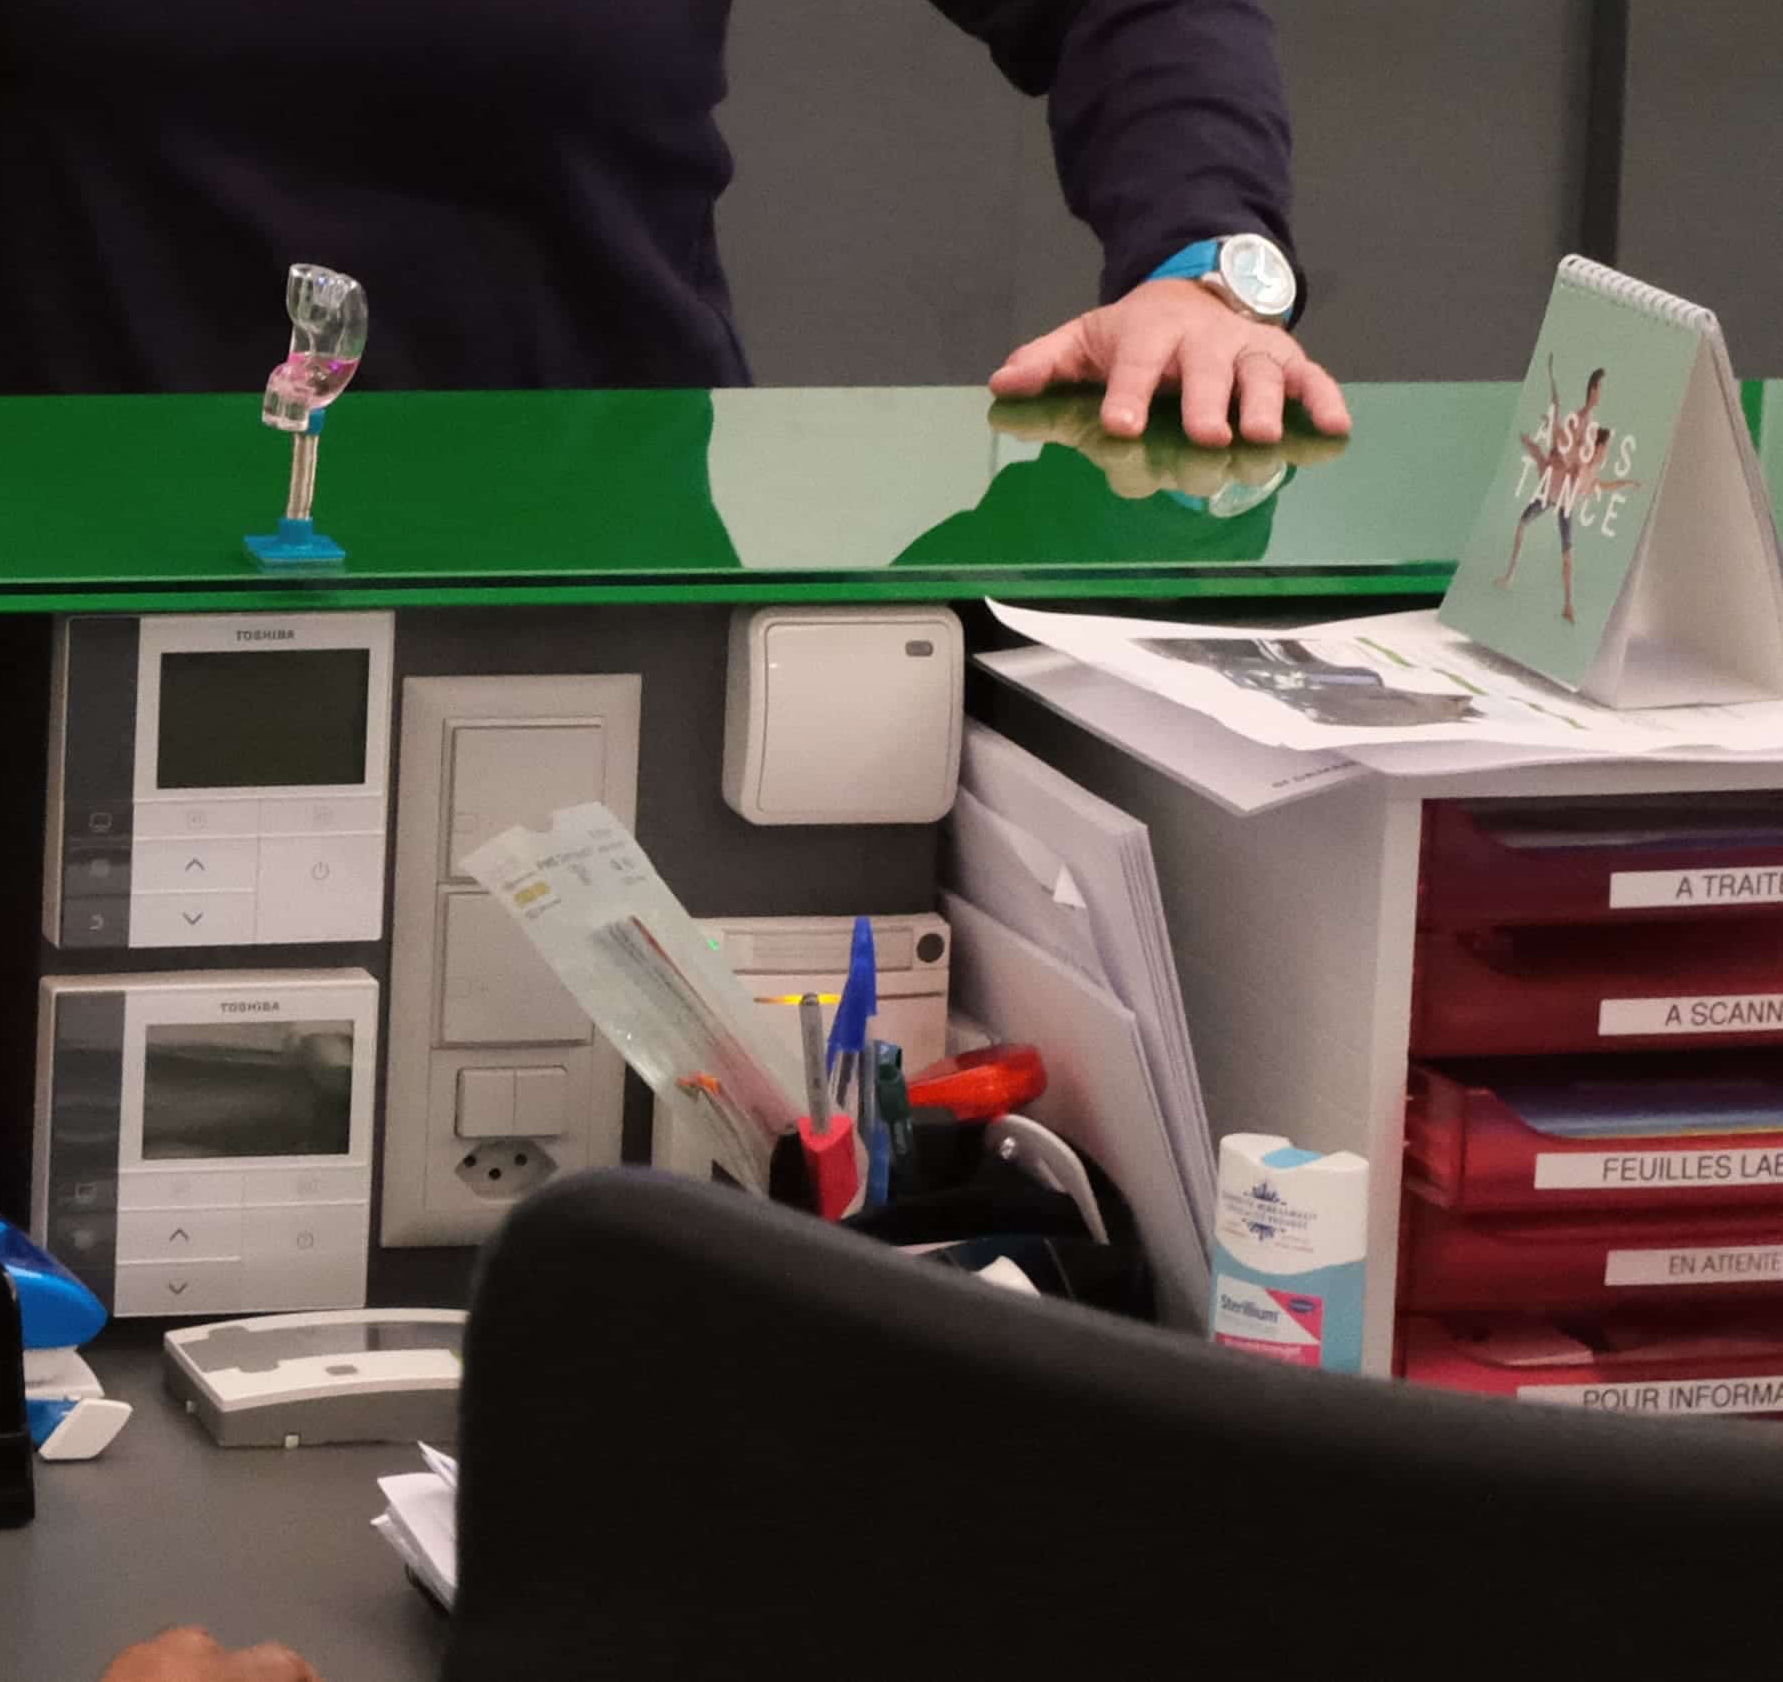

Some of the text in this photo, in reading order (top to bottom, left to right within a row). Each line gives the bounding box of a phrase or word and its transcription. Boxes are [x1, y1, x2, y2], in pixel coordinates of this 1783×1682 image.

[1675, 872, 1783, 900] A TRAIT
[1665, 1004, 1683, 1027] A
[1602, 1154, 1732, 1181] FEUILLES
[1669, 1254, 1697, 1275] EN
[1583, 1387, 1660, 1410] POUR
